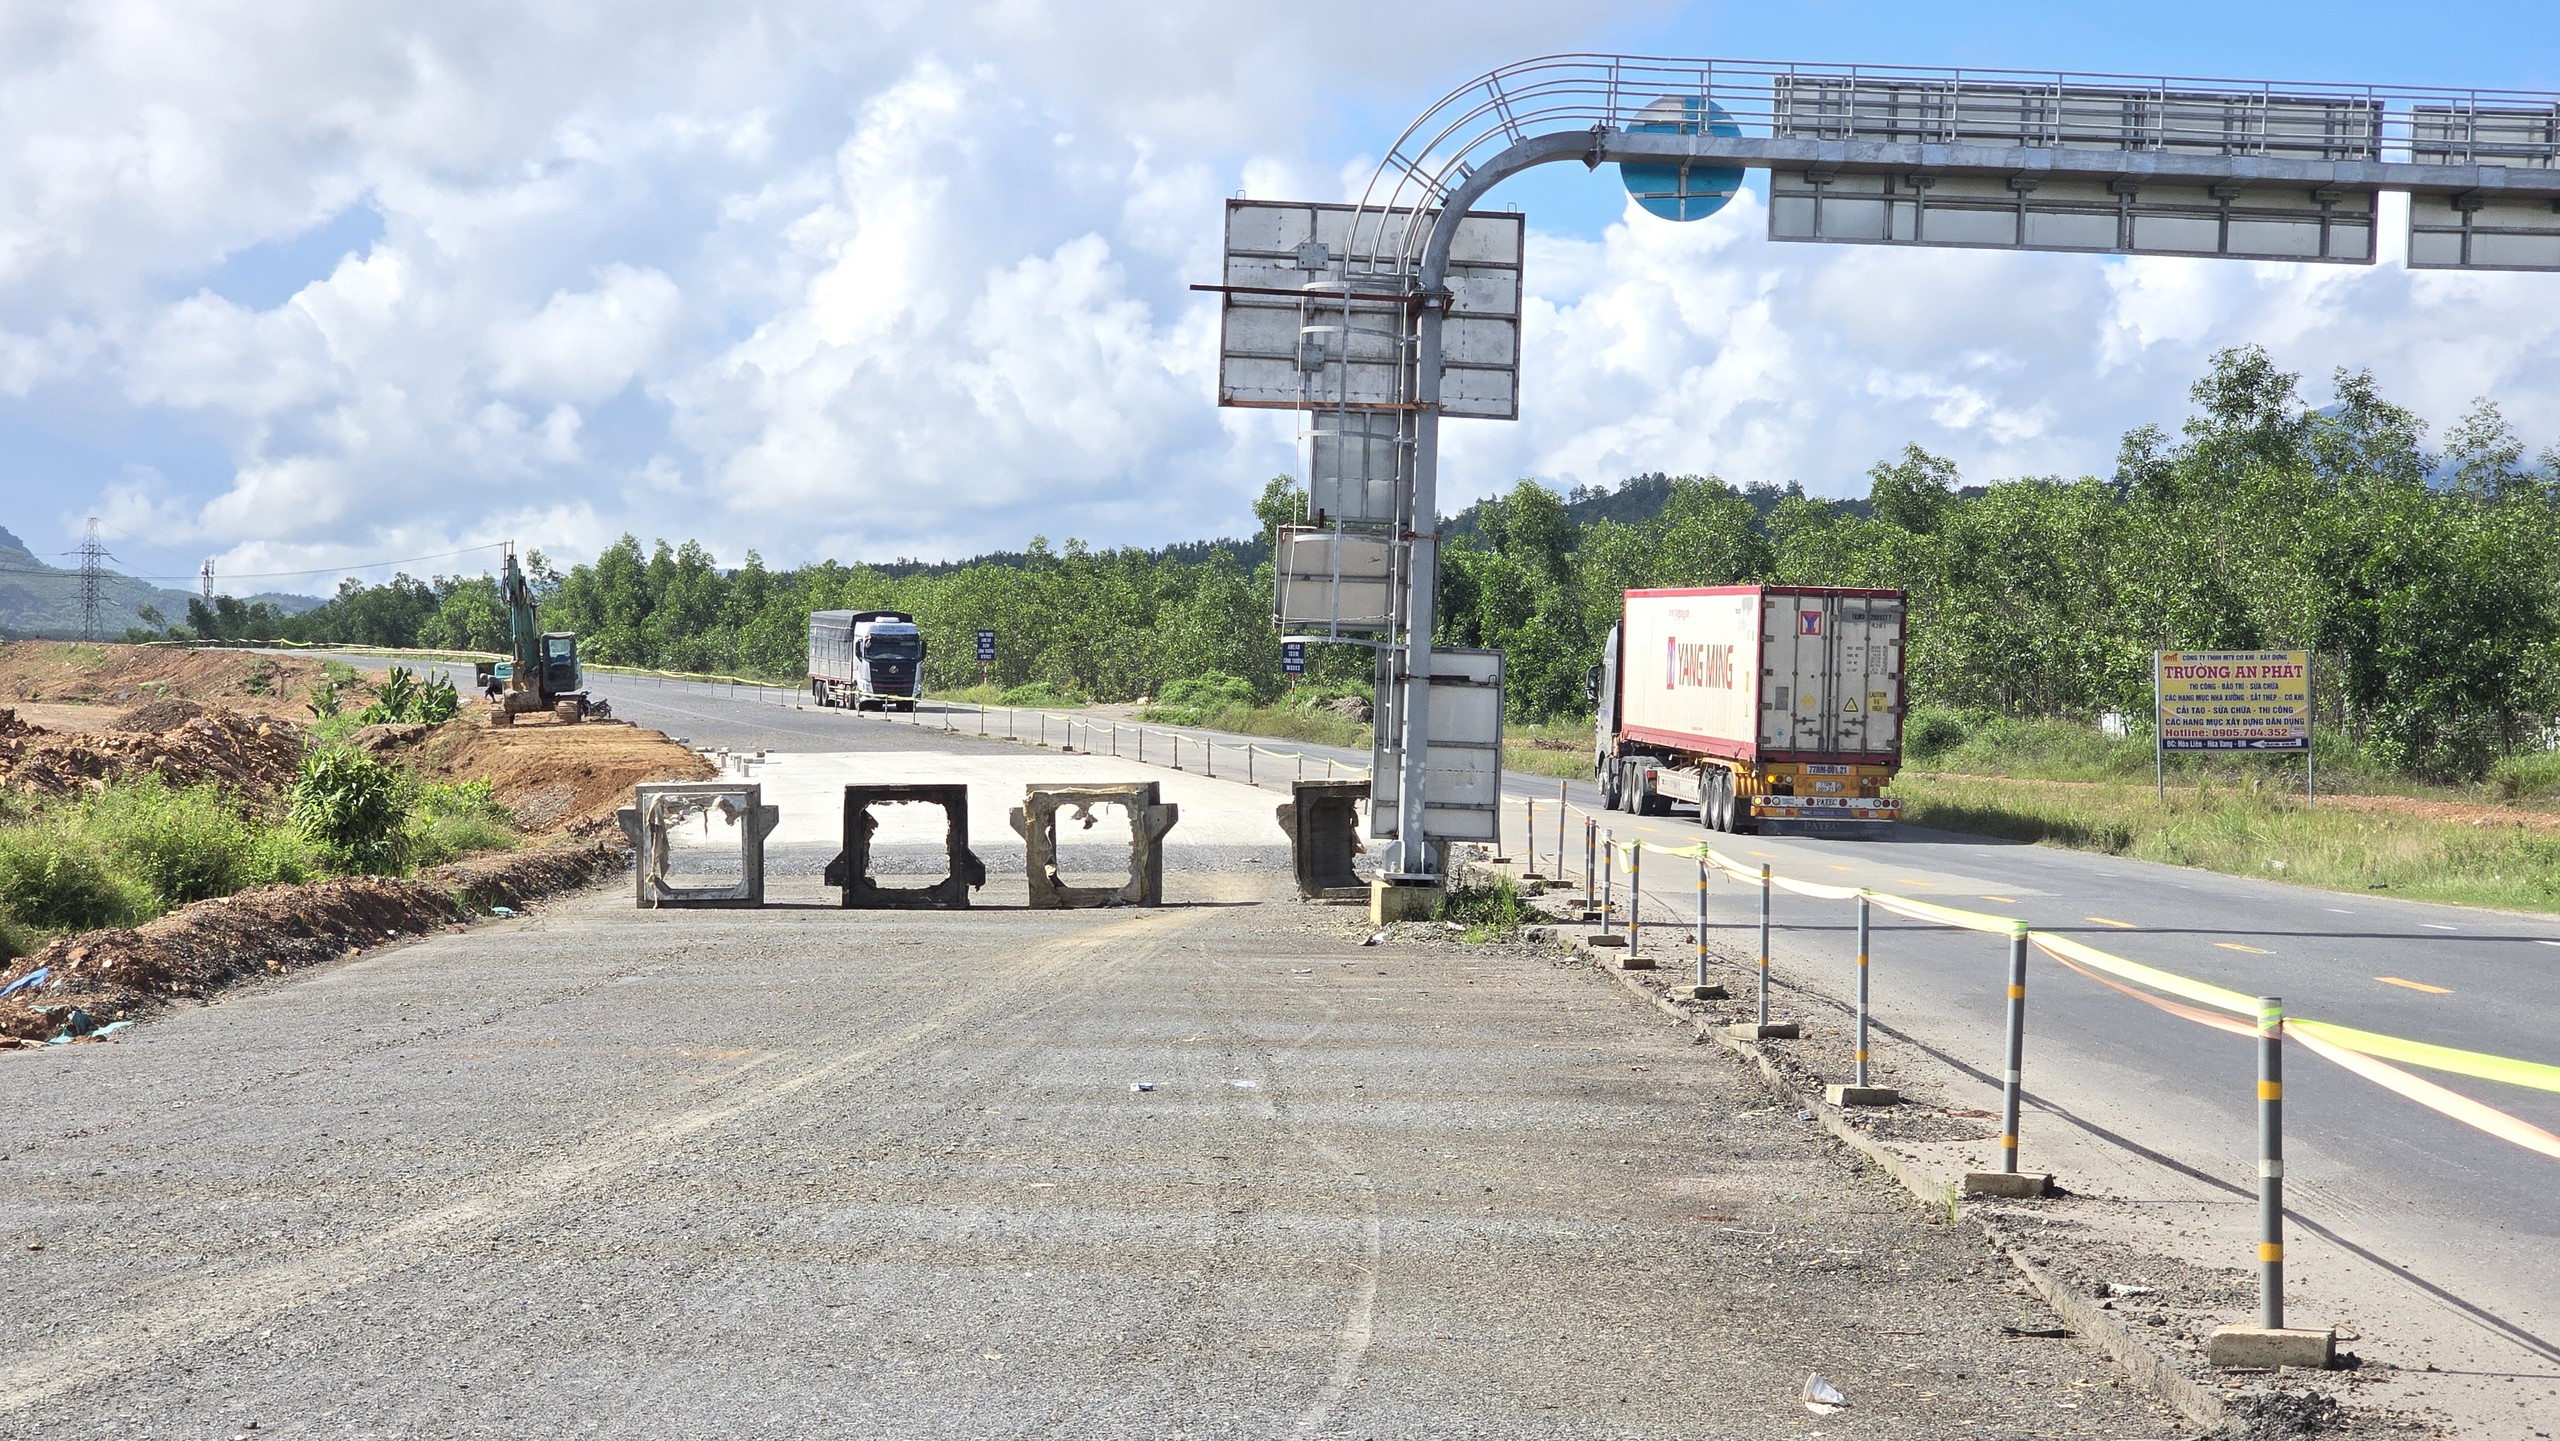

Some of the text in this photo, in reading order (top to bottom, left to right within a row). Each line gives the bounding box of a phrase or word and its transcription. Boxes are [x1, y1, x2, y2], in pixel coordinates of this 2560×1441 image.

[1678, 643, 1733, 690] YANG MING
[2164, 661, 2303, 678] TRƯỜNG AN PHÁT
[2200, 682, 2216, 690] CÔNG
[2164, 693, 2177, 701] CÁC
[2178, 694, 2194, 703] HẠNG
[2195, 694, 2209, 702] MỤC
[2176, 705, 2294, 716] CẢI TẠO SỬA CHỮA THI CÔNG
[2165, 717, 2181, 726] CÁC
[2183, 718, 2204, 727] HẠNG
[2206, 718, 2223, 727] MỤC
[2226, 717, 2241, 726] XÂY
[2266, 717, 2282, 725] DÂN
[2284, 717, 2305, 726] DỤNG
[2165, 729, 2209, 737] Hotline:
[2212, 728, 2288, 737] 0905.704.352
[2190, 740, 2203, 748] Liên
[2220, 740, 2233, 748] Vang
[1816, 798, 1837, 806] PATEC
